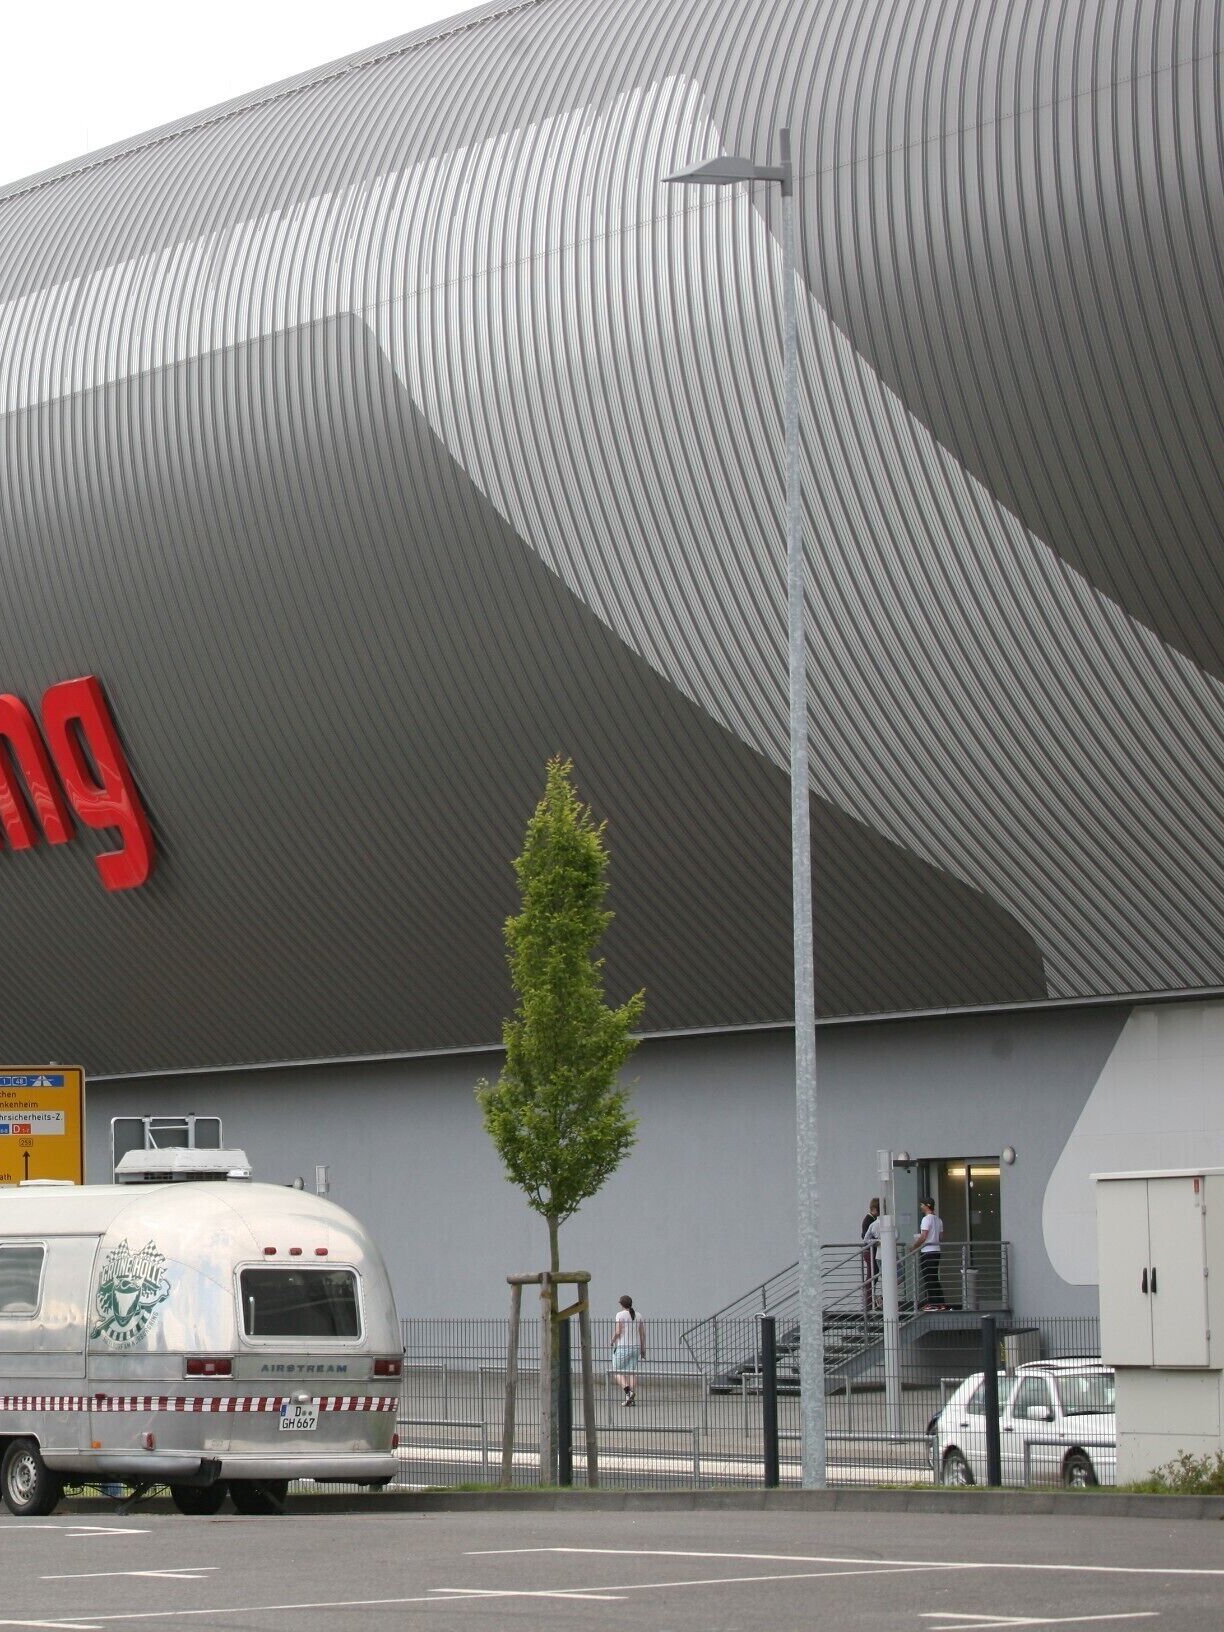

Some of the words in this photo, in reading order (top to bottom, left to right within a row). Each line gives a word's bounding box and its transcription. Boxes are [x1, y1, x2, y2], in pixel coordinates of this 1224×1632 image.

[15, 1077, 24, 1085] 48
[261, 1364, 348, 1373] AIRSTREAM
[295, 1406, 302, 1417] D
[282, 1418, 295, 1429] GH
[296, 1418, 315, 1429] 667
